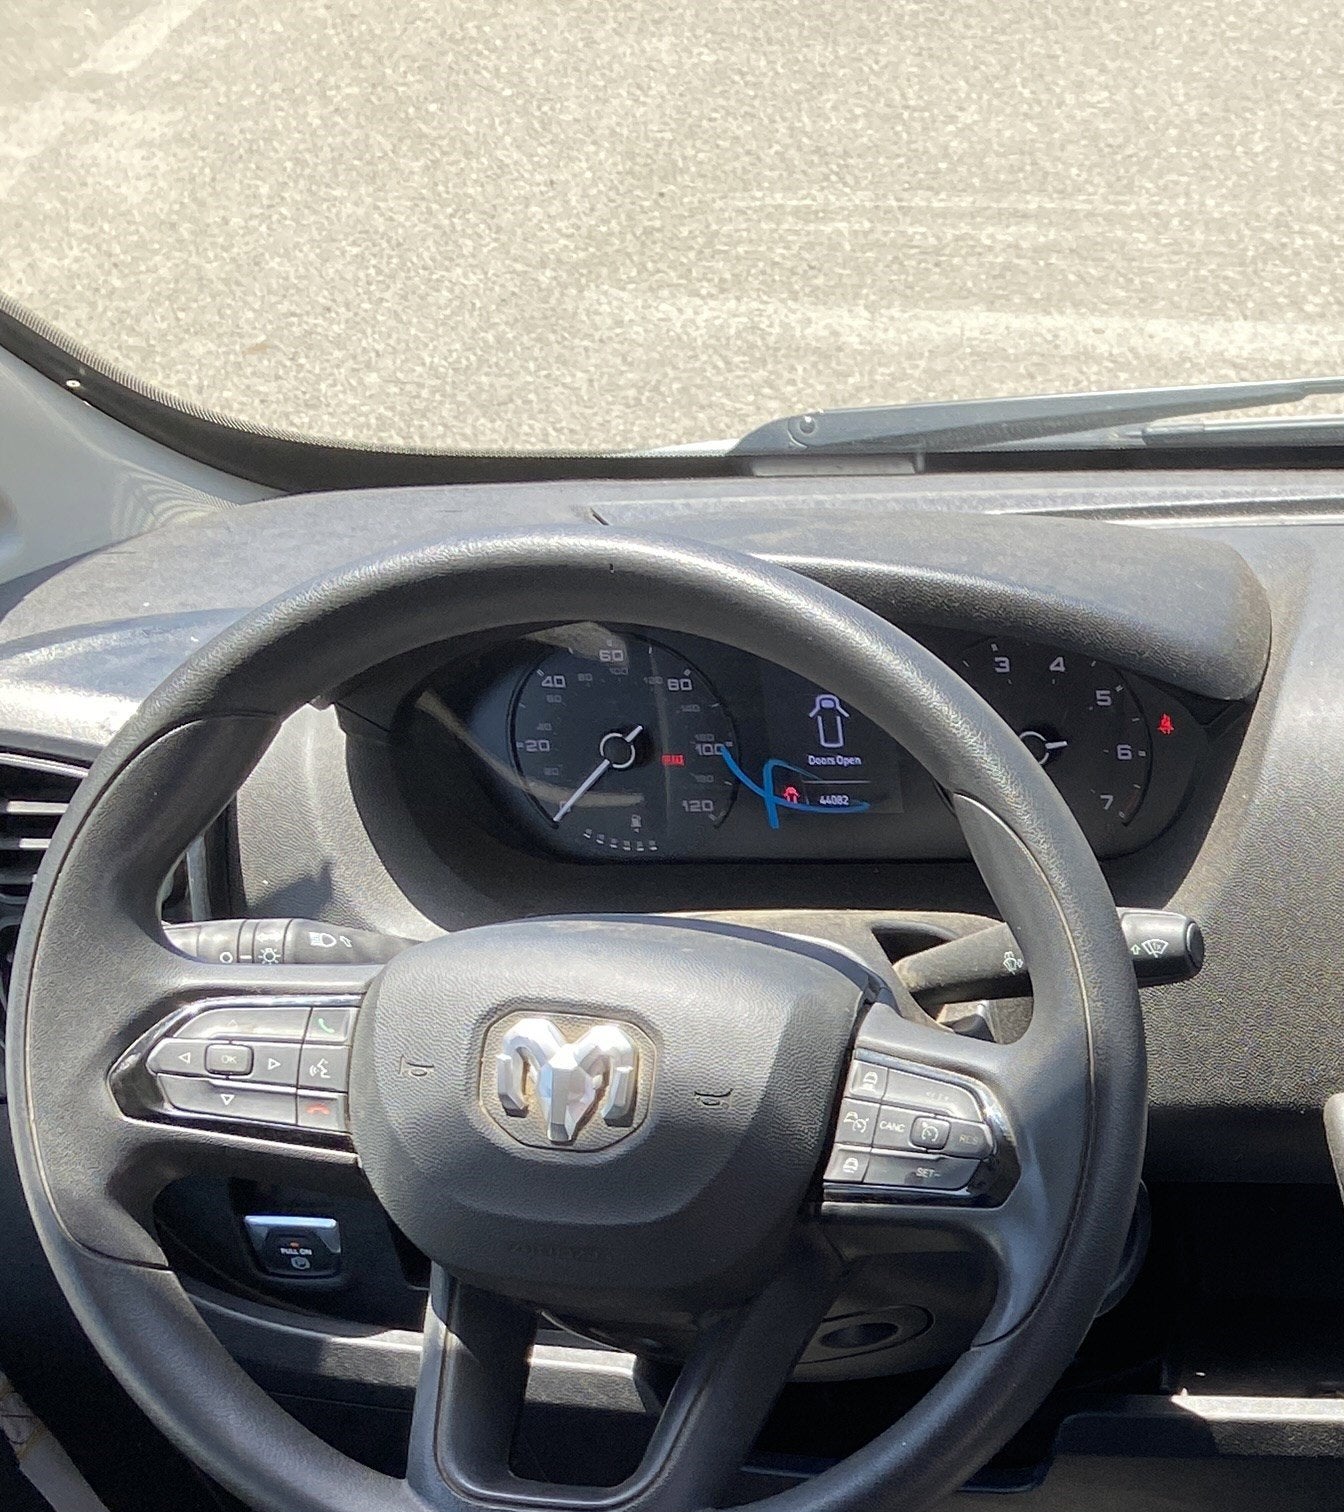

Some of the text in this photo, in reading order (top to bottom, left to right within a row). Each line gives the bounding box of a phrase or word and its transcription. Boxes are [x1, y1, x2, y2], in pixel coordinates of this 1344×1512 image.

[600, 650, 625, 663] 60
[994, 656, 1010, 673] 3
[1049, 656, 1066, 673] 4
[541, 675, 567, 689] 40
[1096, 690, 1112, 706] 5
[524, 739, 550, 752] 20
[1117, 744, 1132, 761] 6
[807, 755, 862, 767] Doors Open
[682, 800, 715, 813] 120
[1100, 794, 1114, 810] 7
[221, 1054, 238, 1065] OK
[879, 1120, 906, 1133] CANC
[958, 1134, 979, 1145] RES
